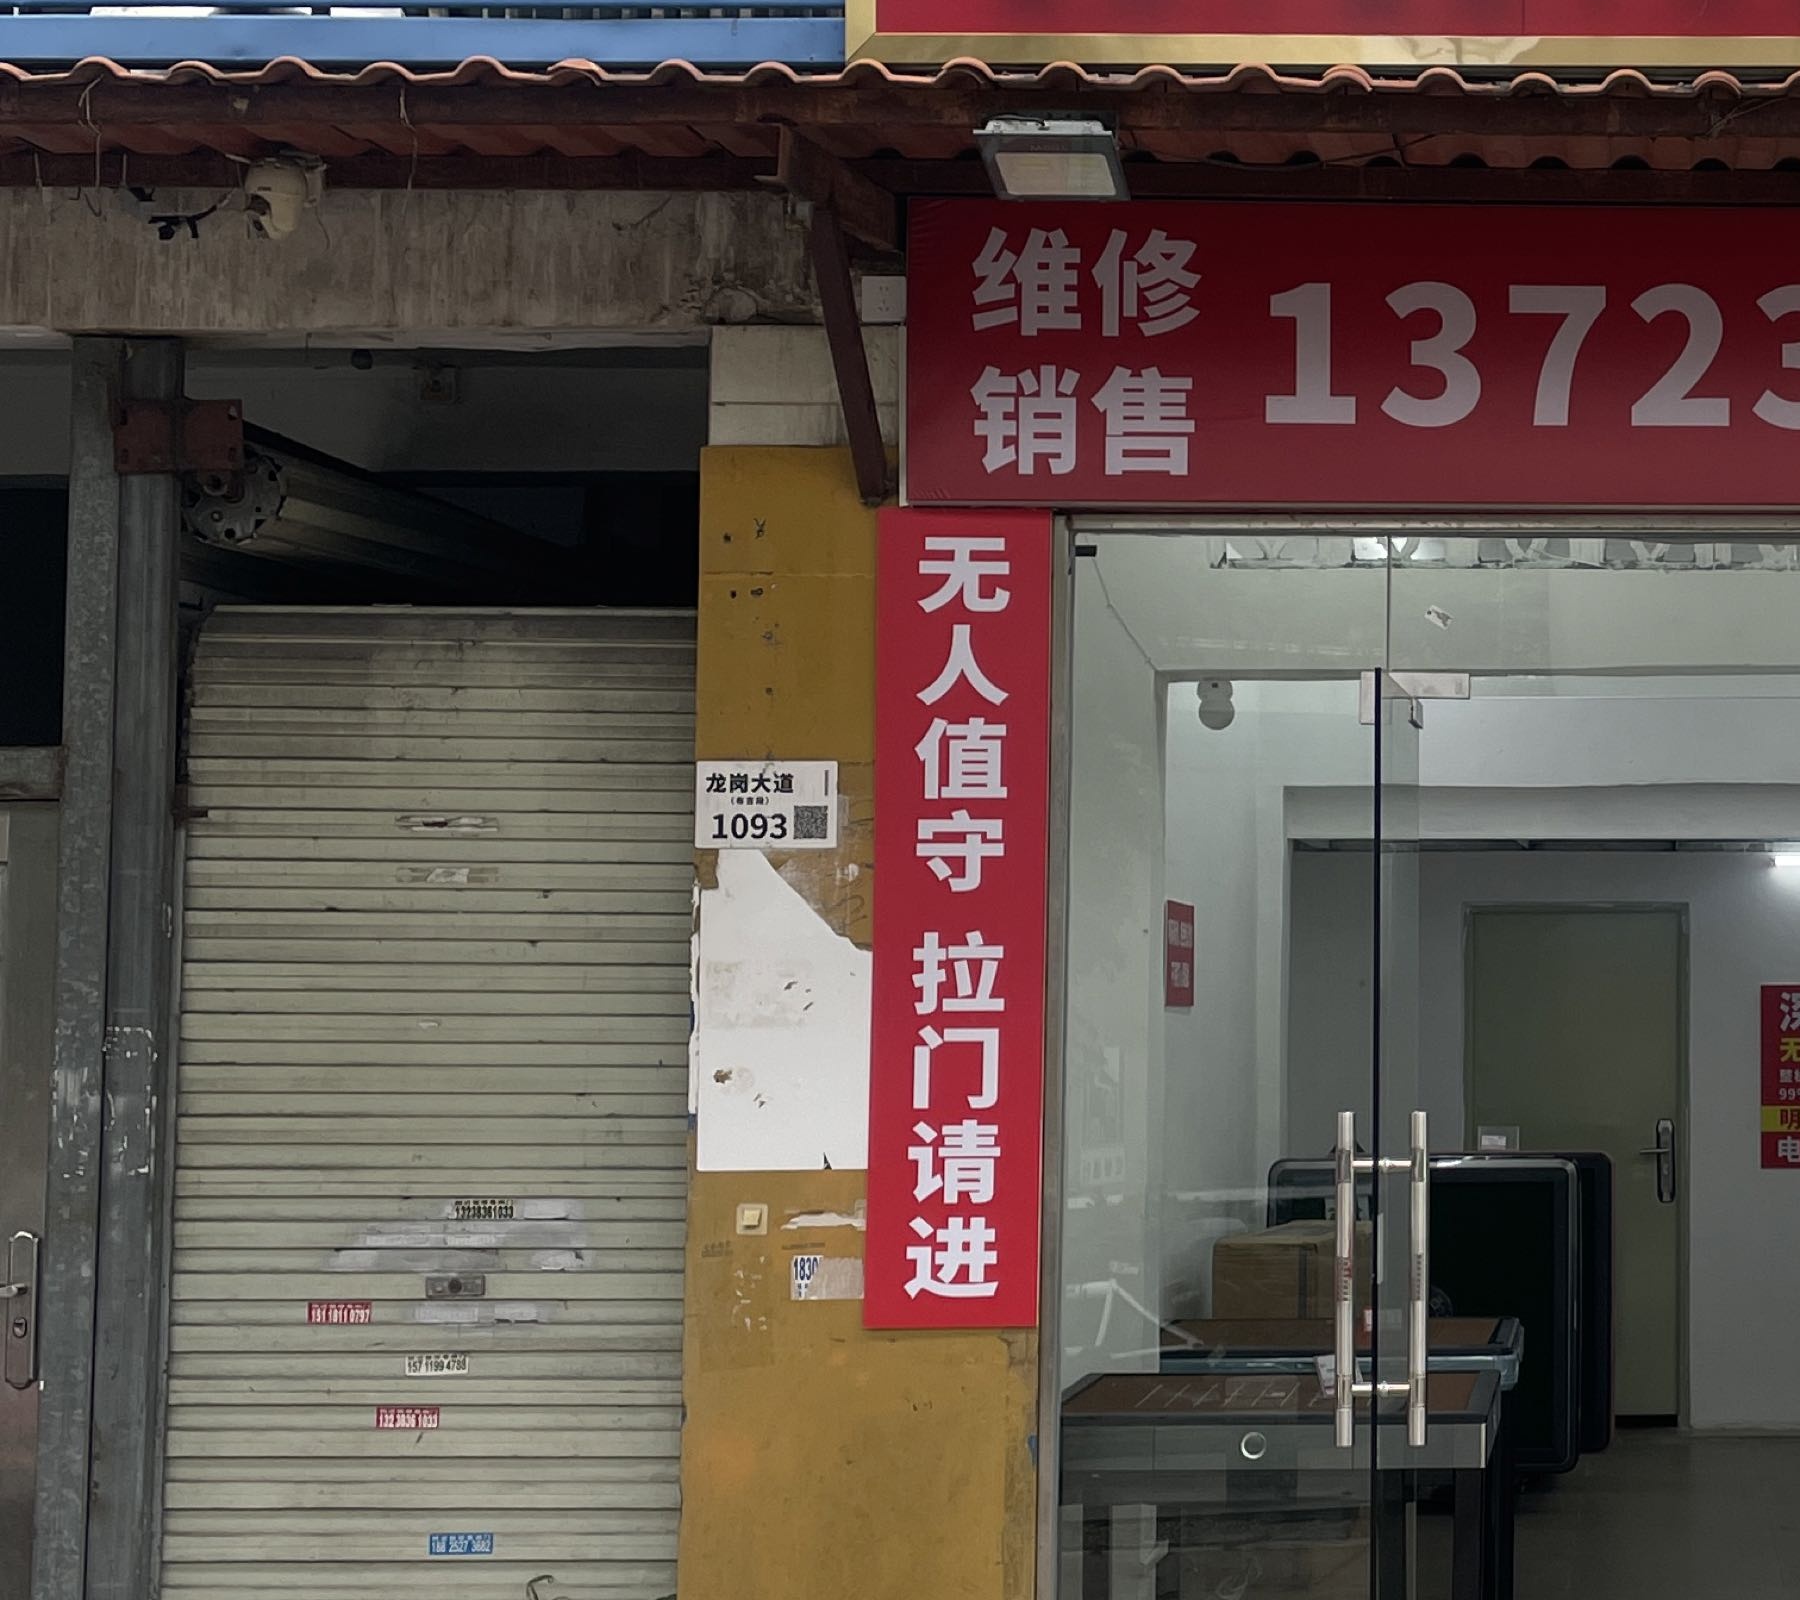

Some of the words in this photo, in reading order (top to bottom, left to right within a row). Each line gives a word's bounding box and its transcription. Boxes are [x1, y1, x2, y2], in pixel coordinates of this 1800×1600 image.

[971, 226, 1202, 338] 维修
[970, 364, 1196, 477] 销售
[914, 536, 1012, 893] 无人值守
[705, 772, 795, 794] 龙岗大道
[712, 813, 788, 840] 1093
[904, 930, 1006, 1300] 拉门请进
